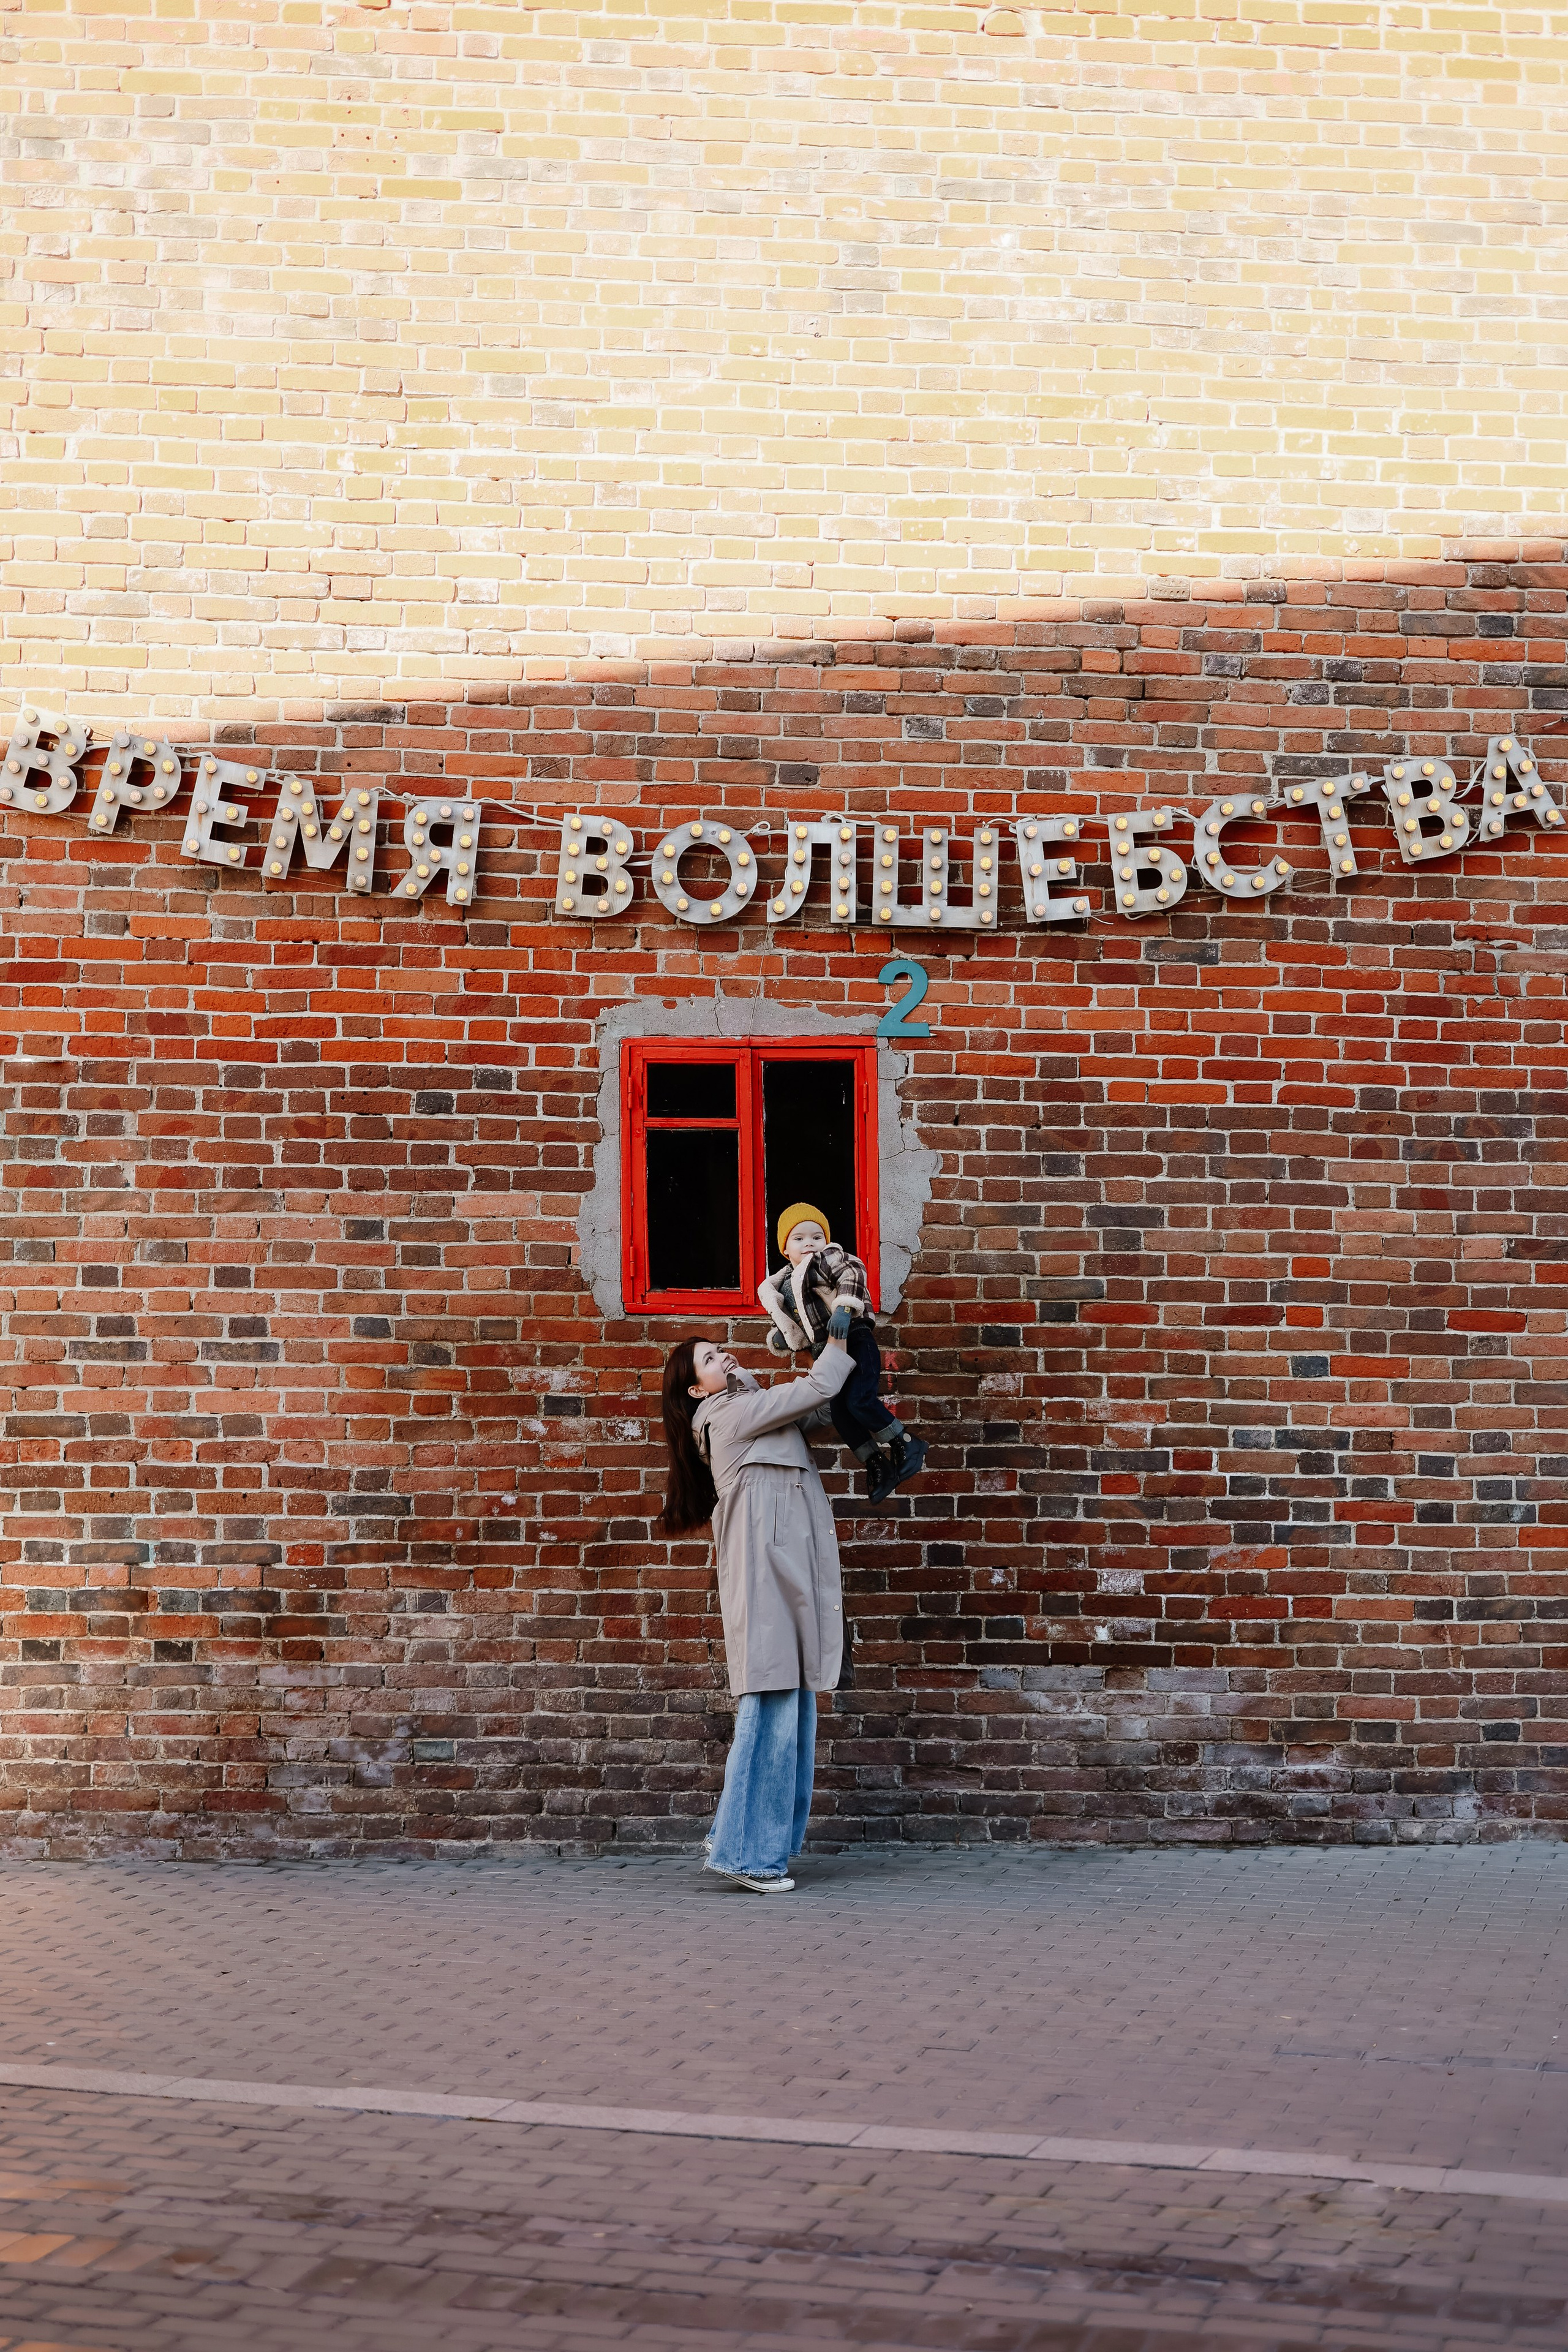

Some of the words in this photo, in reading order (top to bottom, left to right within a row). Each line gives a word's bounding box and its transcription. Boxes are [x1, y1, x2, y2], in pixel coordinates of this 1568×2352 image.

[0, 703, 481, 906] ВРЕМЯ
[554, 735, 1566, 929] ВОЛШЕБСТВА
[876, 959, 930, 1037] 2
